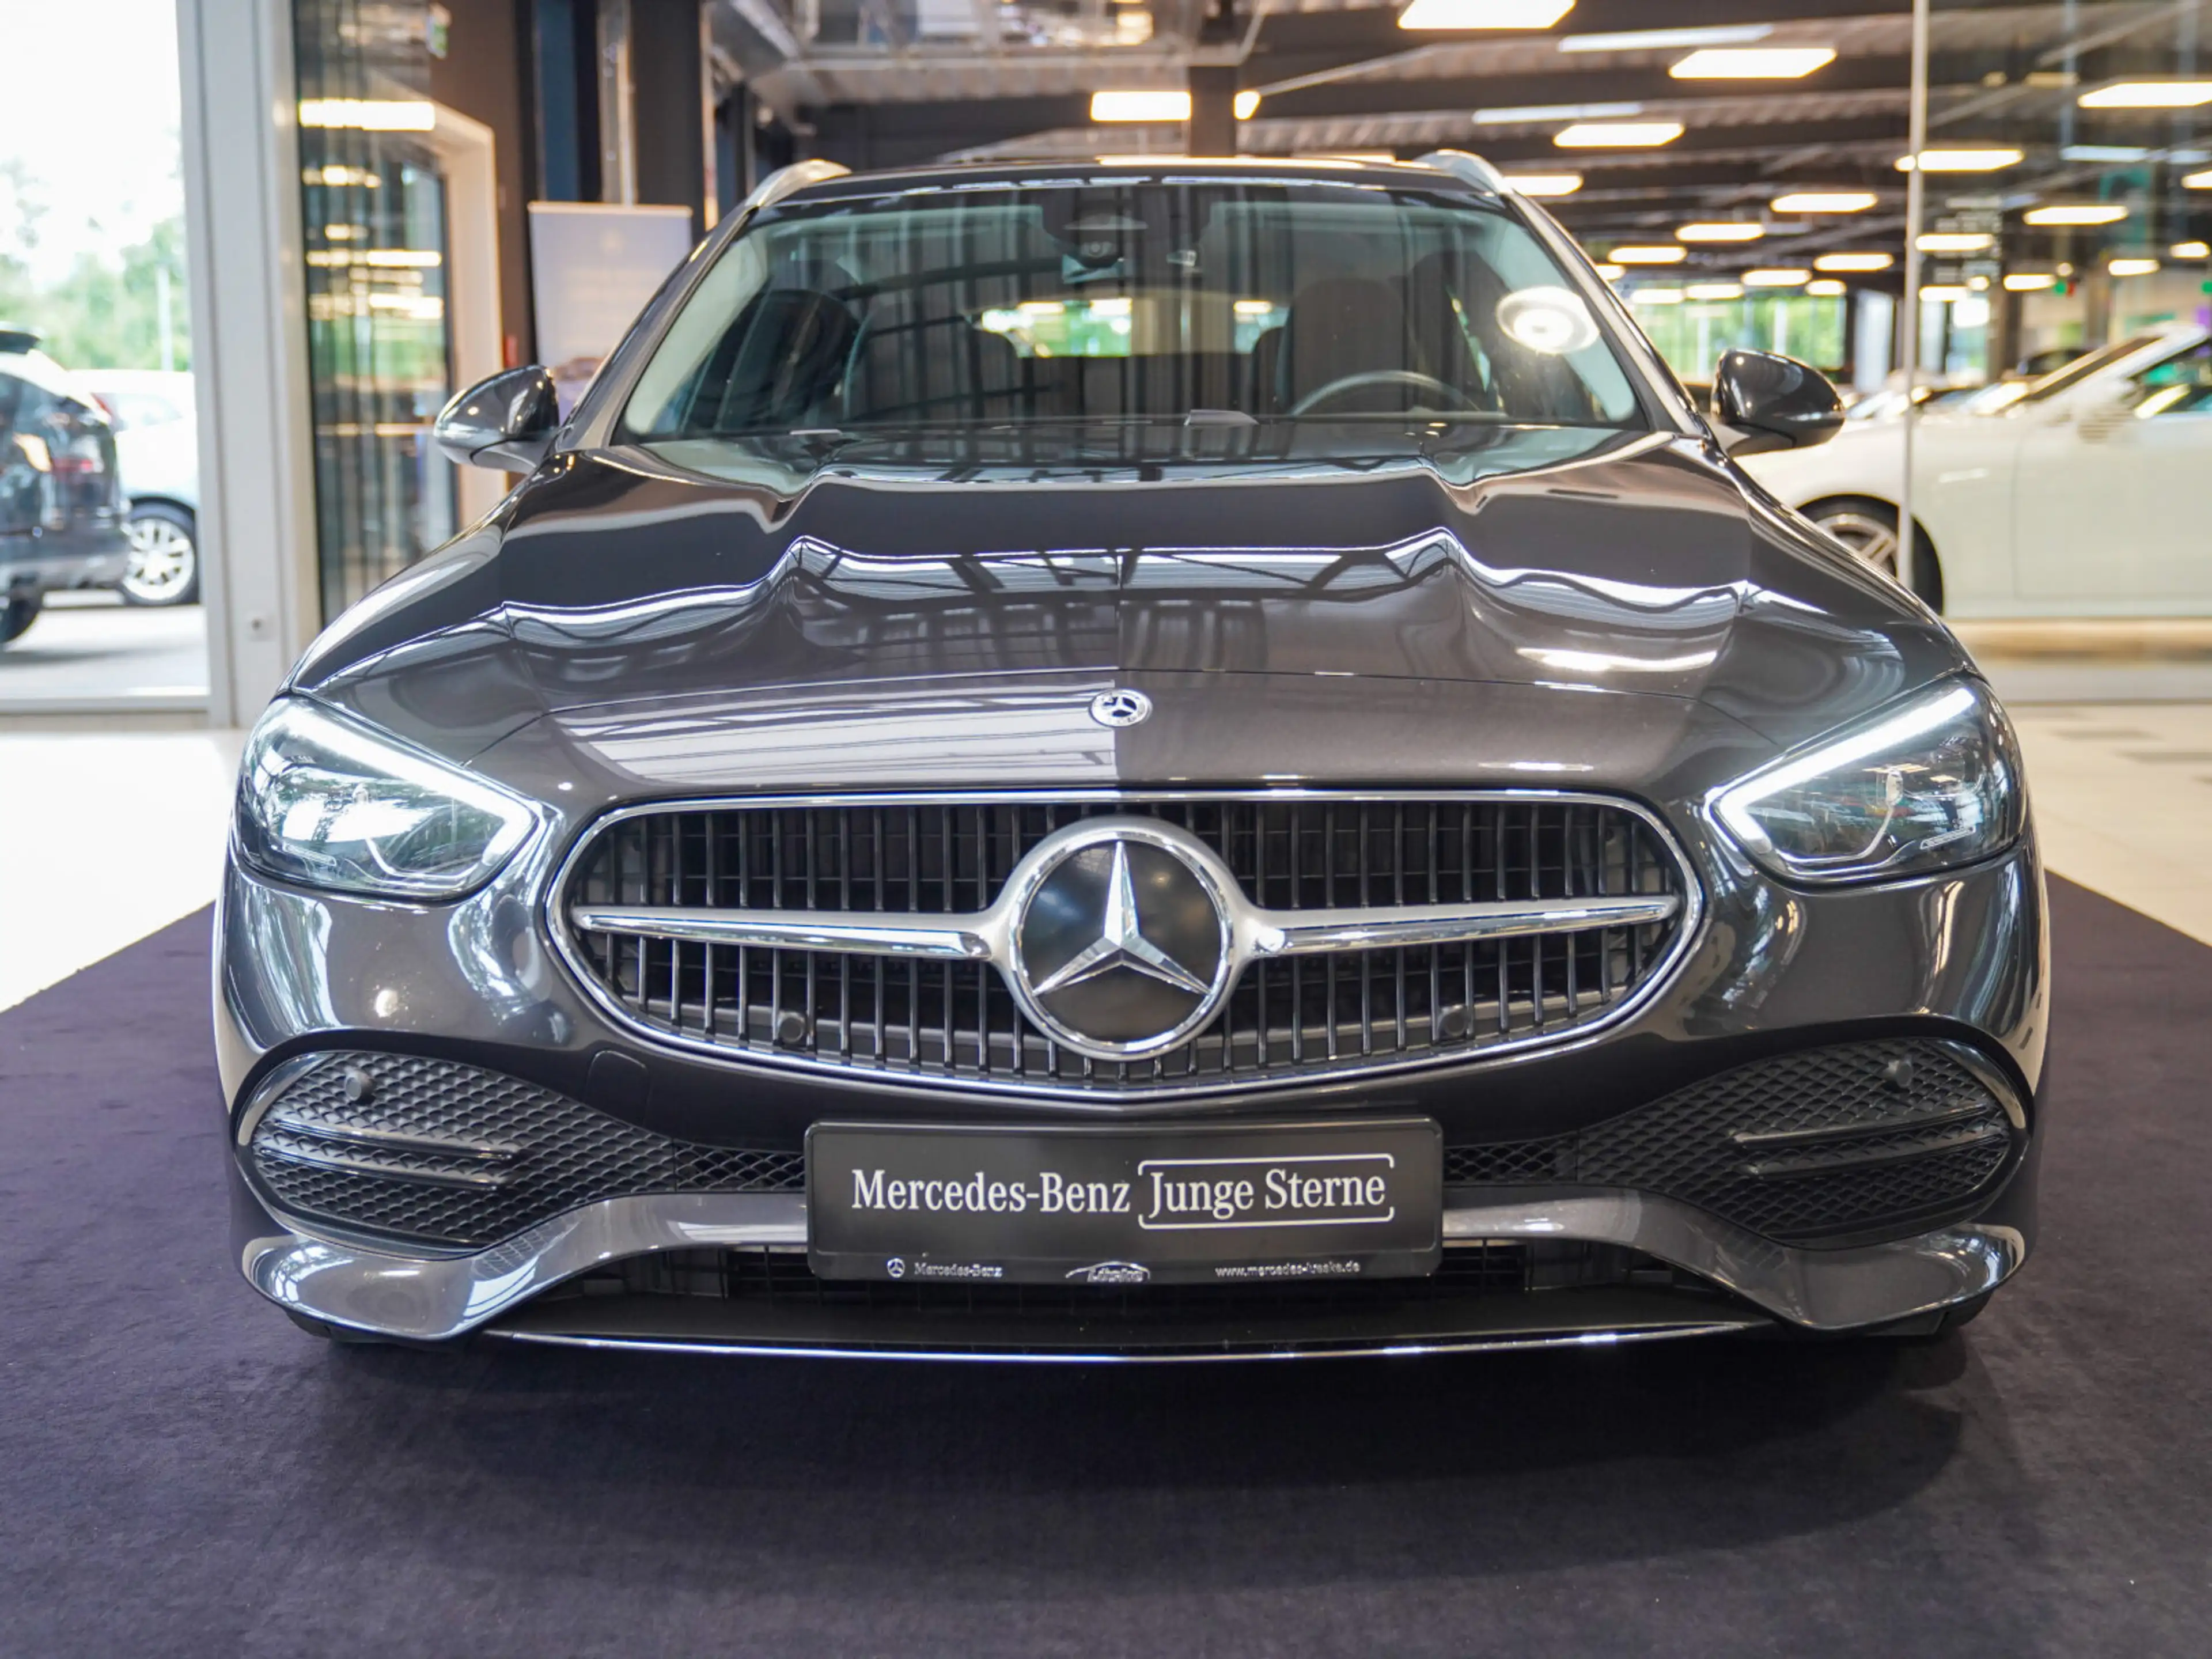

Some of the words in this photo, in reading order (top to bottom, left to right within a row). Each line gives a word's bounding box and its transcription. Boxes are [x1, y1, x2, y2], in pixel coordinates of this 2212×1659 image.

[851, 1169, 1131, 1213] Mercedes-Benz
[1148, 1172, 1255, 1220] Junge
[1264, 1168, 1386, 1210] Sterne
[914, 1262, 1002, 1278] Mercedes-Benz
